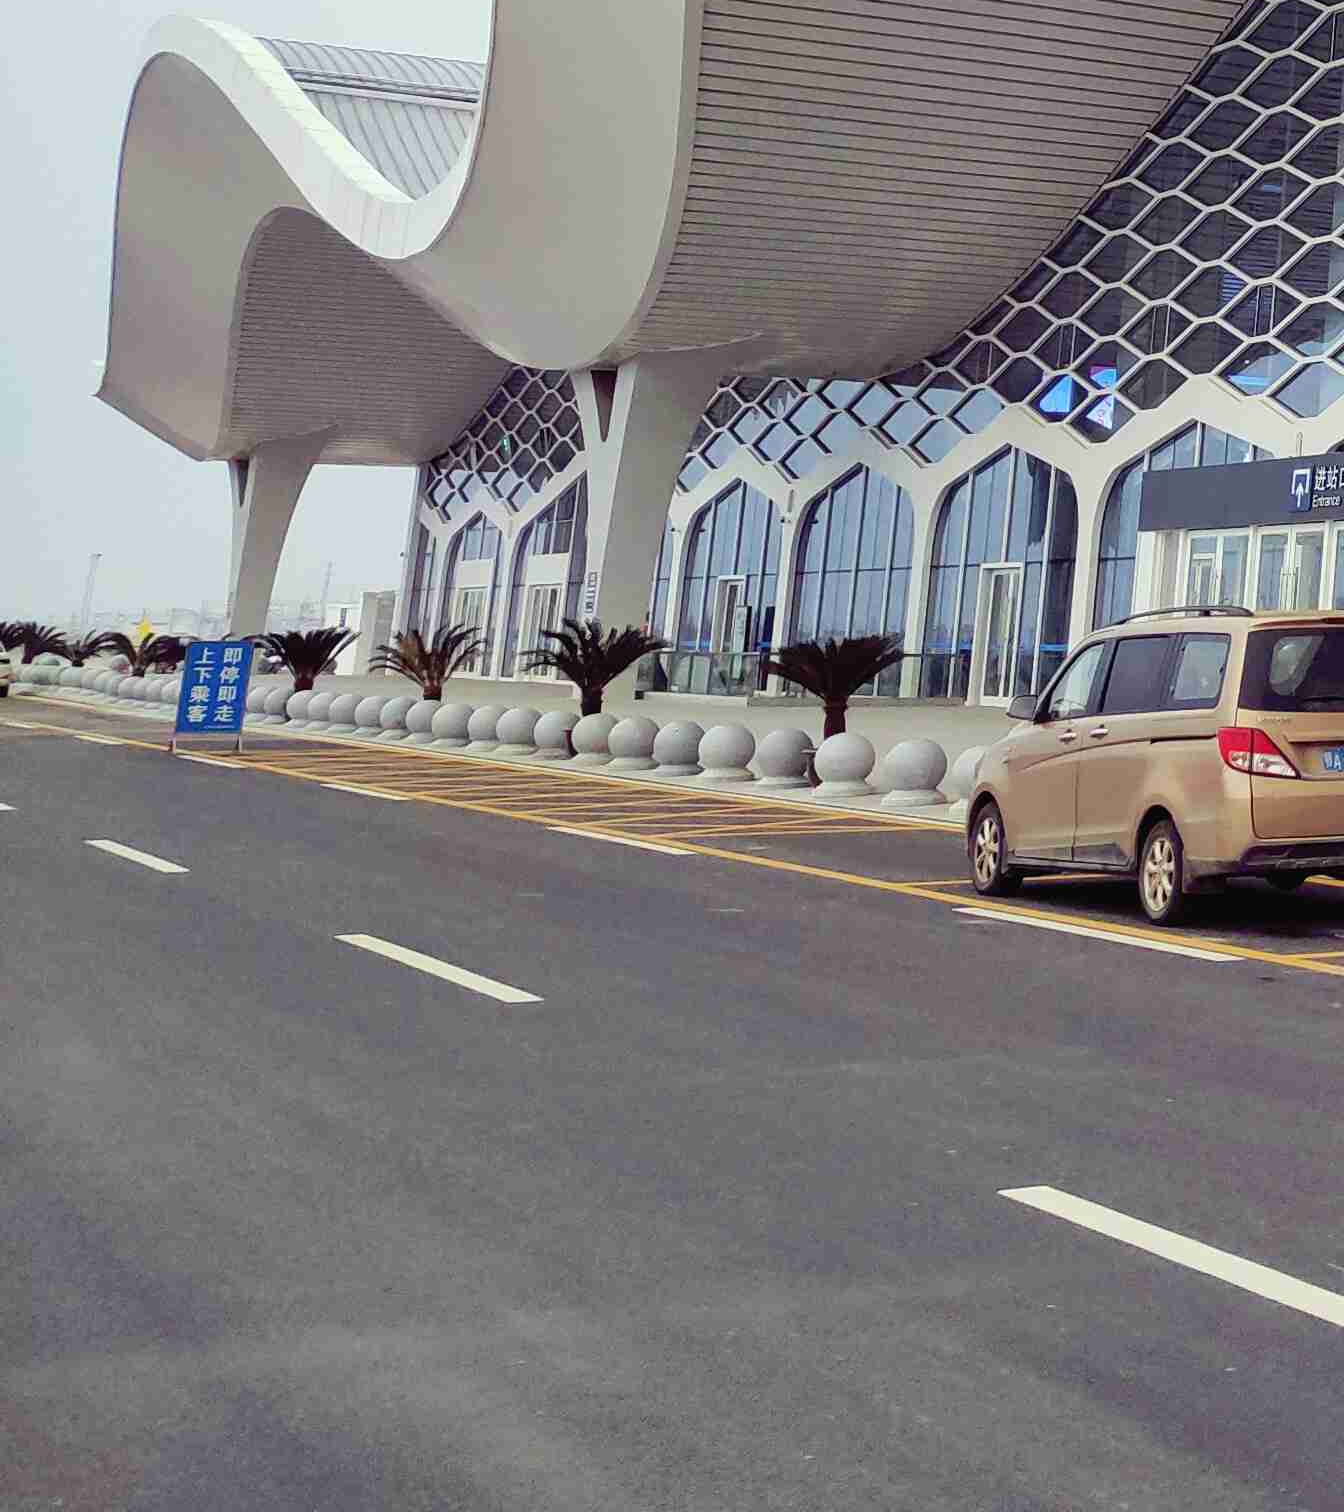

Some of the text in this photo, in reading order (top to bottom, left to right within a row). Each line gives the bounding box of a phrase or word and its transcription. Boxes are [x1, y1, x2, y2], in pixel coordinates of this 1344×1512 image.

[1312, 494, 1342, 508] Entrance
[186, 647, 216, 723] 上下乘客
[213, 647, 243, 723] 即停即走
